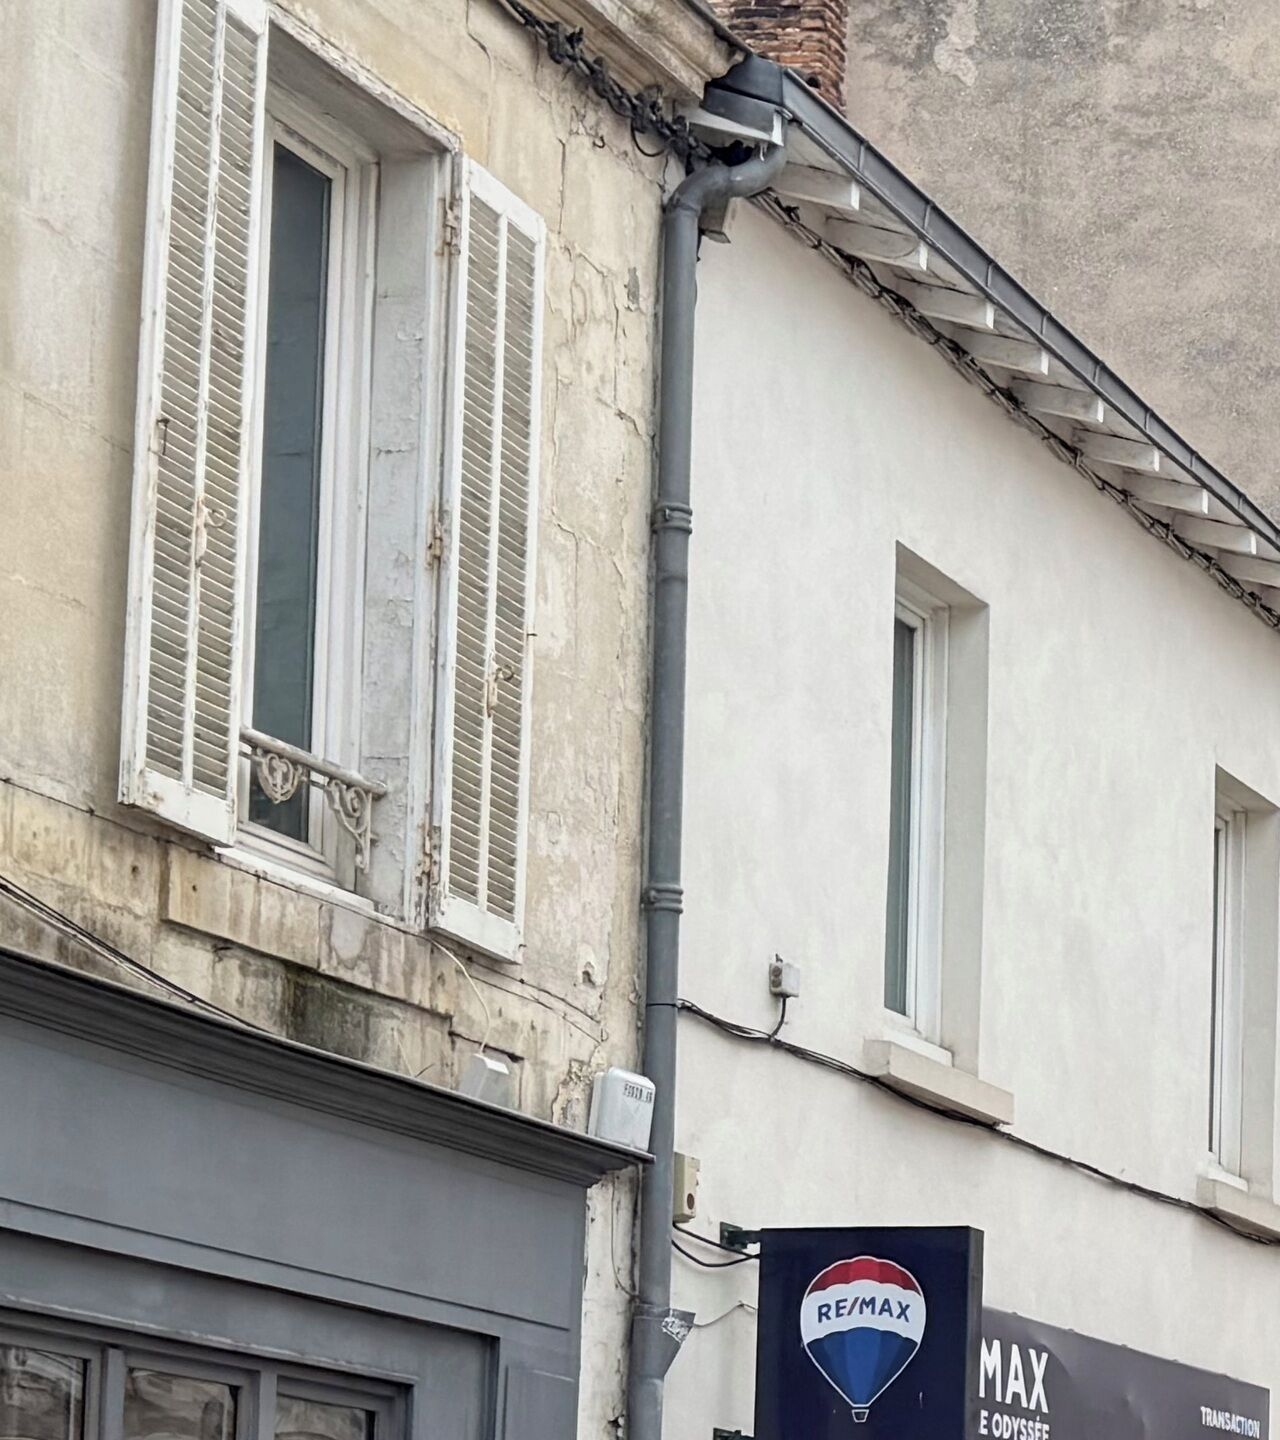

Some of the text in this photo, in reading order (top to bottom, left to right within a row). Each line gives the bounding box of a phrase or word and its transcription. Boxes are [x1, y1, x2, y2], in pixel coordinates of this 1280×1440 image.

[817, 1296, 911, 1324] RE/MAX
[979, 1337, 1050, 1413] MAX
[1200, 1406, 1260, 1438] TRANSACTION
